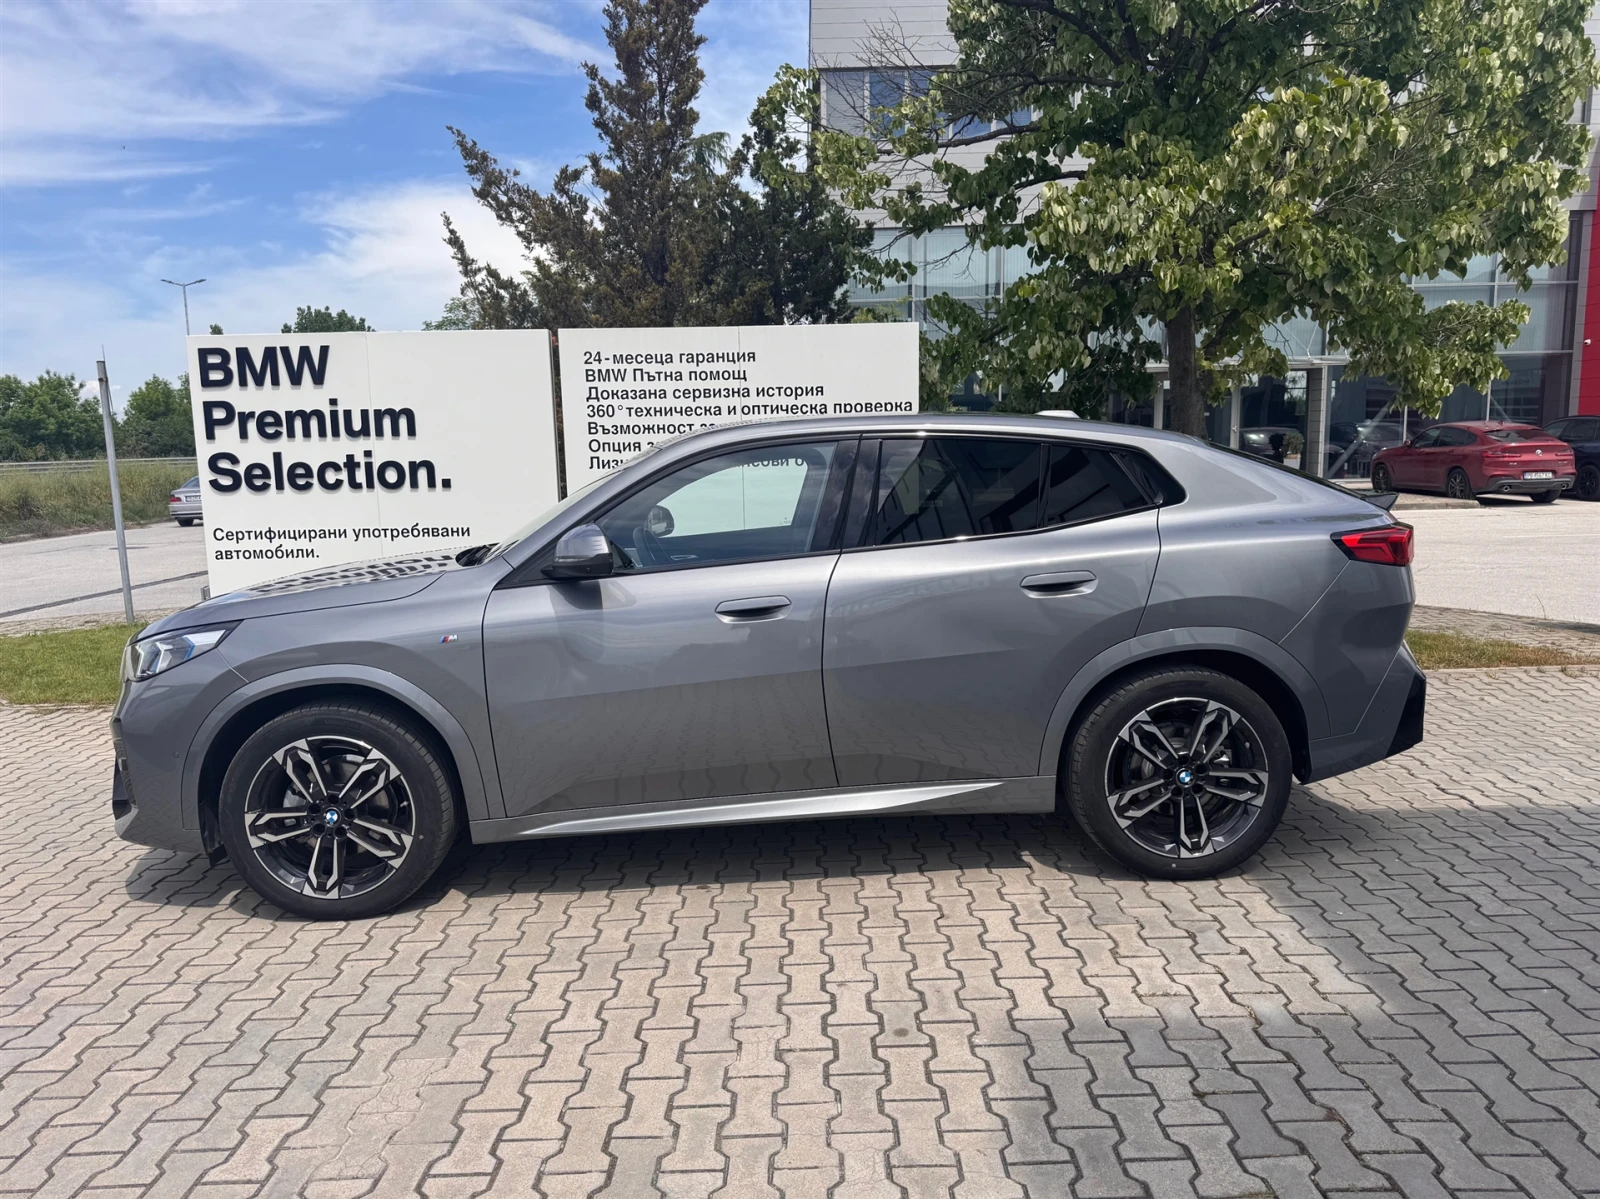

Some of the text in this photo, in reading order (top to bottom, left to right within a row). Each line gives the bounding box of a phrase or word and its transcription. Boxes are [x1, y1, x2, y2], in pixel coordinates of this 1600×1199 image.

[197, 345, 330, 388] BMW
[679, 351, 756, 367] гаранция
[585, 368, 747, 382] BMW Пътна помощ
[586, 386, 824, 402] Доказана сервизна история
[625, 405, 722, 417] техническа
[727, 405, 737, 416] и
[740, 403, 828, 415] оптическа
[833, 401, 913, 414] проверка
[202, 398, 417, 440] Premium
[587, 421, 695, 435] Възможност
[588, 438, 641, 453] Опция
[207, 450, 452, 492] Selection.
[212, 523, 471, 544] Сертифицирани употребявани
[214, 544, 320, 560] автомобили.
